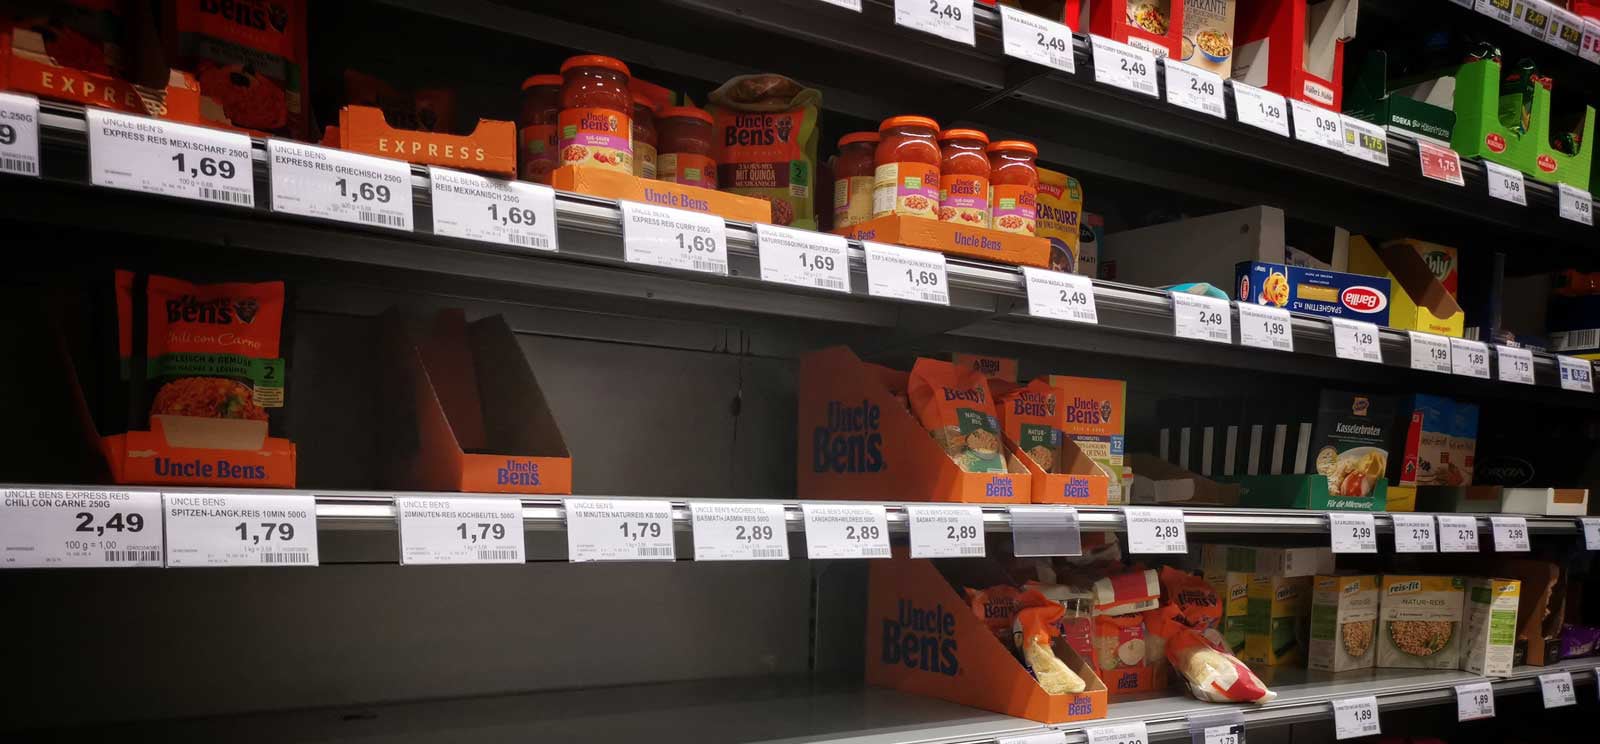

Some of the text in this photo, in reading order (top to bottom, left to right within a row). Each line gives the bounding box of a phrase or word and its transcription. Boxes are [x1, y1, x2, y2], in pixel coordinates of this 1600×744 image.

[930, 0, 962, 21] 2,49
[1037, 33, 1066, 51] 2,49
[1120, 58, 1147, 76] 2,49
[1191, 78, 1215, 95] 2,49
[587, 112, 608, 123] Uncle
[1259, 103, 1280, 119] 1,29
[736, 112, 772, 129] Uncle
[1316, 117, 1337, 132] 0,99
[1392, 115, 1411, 127] EDEKA
[103, 128, 249, 160] EXPRESS REIS MEXI.SCHARF 250G
[379, 138, 486, 161] EXPRESS
[1363, 134, 1383, 151] 1,75
[275, 146, 302, 158] UNCLE
[171, 153, 236, 179] 1,69
[275, 156, 402, 184] EXPRESS REIS GRIECHISCH 250G
[1438, 158, 1456, 172] 1,75
[434, 173, 458, 184] UNCLE
[749, 169, 776, 181] QUINOA
[335, 179, 391, 203] 1,69
[1504, 179, 1519, 192] 0,69
[435, 183, 520, 203] REIS MEXIKANISCH 250G
[644, 188, 677, 206] Uncle
[1575, 200, 1589, 213] 0,69
[488, 204, 536, 226] 1,69
[632, 216, 711, 233] EXPRESS REIS CURRY 250G
[675, 232, 716, 253] 1,69
[955, 232, 980, 247] Uncle
[799, 252, 835, 271] 1,69
[906, 269, 938, 286] 1,69
[1060, 290, 1087, 304] 2,49
[1345, 293, 1376, 307] Barilla
[1305, 303, 1342, 314] SPAGHETTINI
[1199, 310, 1223, 326] 2,49
[1264, 322, 1284, 335] 1,99
[194, 332, 261, 350] con Carne
[1354, 333, 1372, 345] 1,29
[1430, 347, 1447, 360] 1,99
[1468, 353, 1484, 365] 1,89
[263, 366, 275, 380] 2
[1514, 361, 1529, 372] 1,79
[1074, 397, 1099, 411] Uncle
[828, 400, 880, 429] Uncle
[1336, 422, 1382, 438] Kasselerbraten
[1113, 441, 1122, 449] 12
[154, 457, 213, 478] Uncle
[507, 460, 538, 471] Uncle
[992, 476, 1012, 486] Uncle
[1071, 477, 1089, 487] Uncle
[4, 491, 129, 501] UNCLE BENS EXPRESS REIS
[171, 498, 226, 506] UNCLE BENS
[5, 499, 111, 509] CHILI CON CARNE 250G
[403, 501, 428, 509] UNCLE
[1327, 499, 1336, 509] Für
[262, 510, 287, 518] 10MIN
[287, 510, 307, 519] 500G
[404, 511, 456, 519] 20MINUTEN-REIS
[458, 512, 499, 520] KOCHBEUTEL
[576, 511, 582, 519] 10
[583, 511, 610, 519] MINUTEN
[75, 512, 145, 536] 2,49
[619, 521, 661, 541] 1,79
[235, 522, 295, 545] 1,79
[457, 522, 506, 543] 1,79
[735, 525, 773, 543] 2,89
[846, 525, 880, 542] 2,89
[947, 525, 977, 543] 2,89
[1155, 526, 1178, 540] 2,89
[1353, 527, 1371, 541] 2,99
[1413, 529, 1430, 541] 2,79
[1458, 529, 1474, 541] 2,79
[1508, 529, 1523, 541] 2,99
[65, 541, 117, 550] 100 1,00
[1389, 581, 1420, 594] reis-fit
[897, 599, 956, 637] Uncle
[1557, 683, 1570, 694] 1,89
[1073, 695, 1092, 705] Uncle
[1474, 694, 1489, 706] 1,89
[1354, 709, 1371, 722] 1,89
